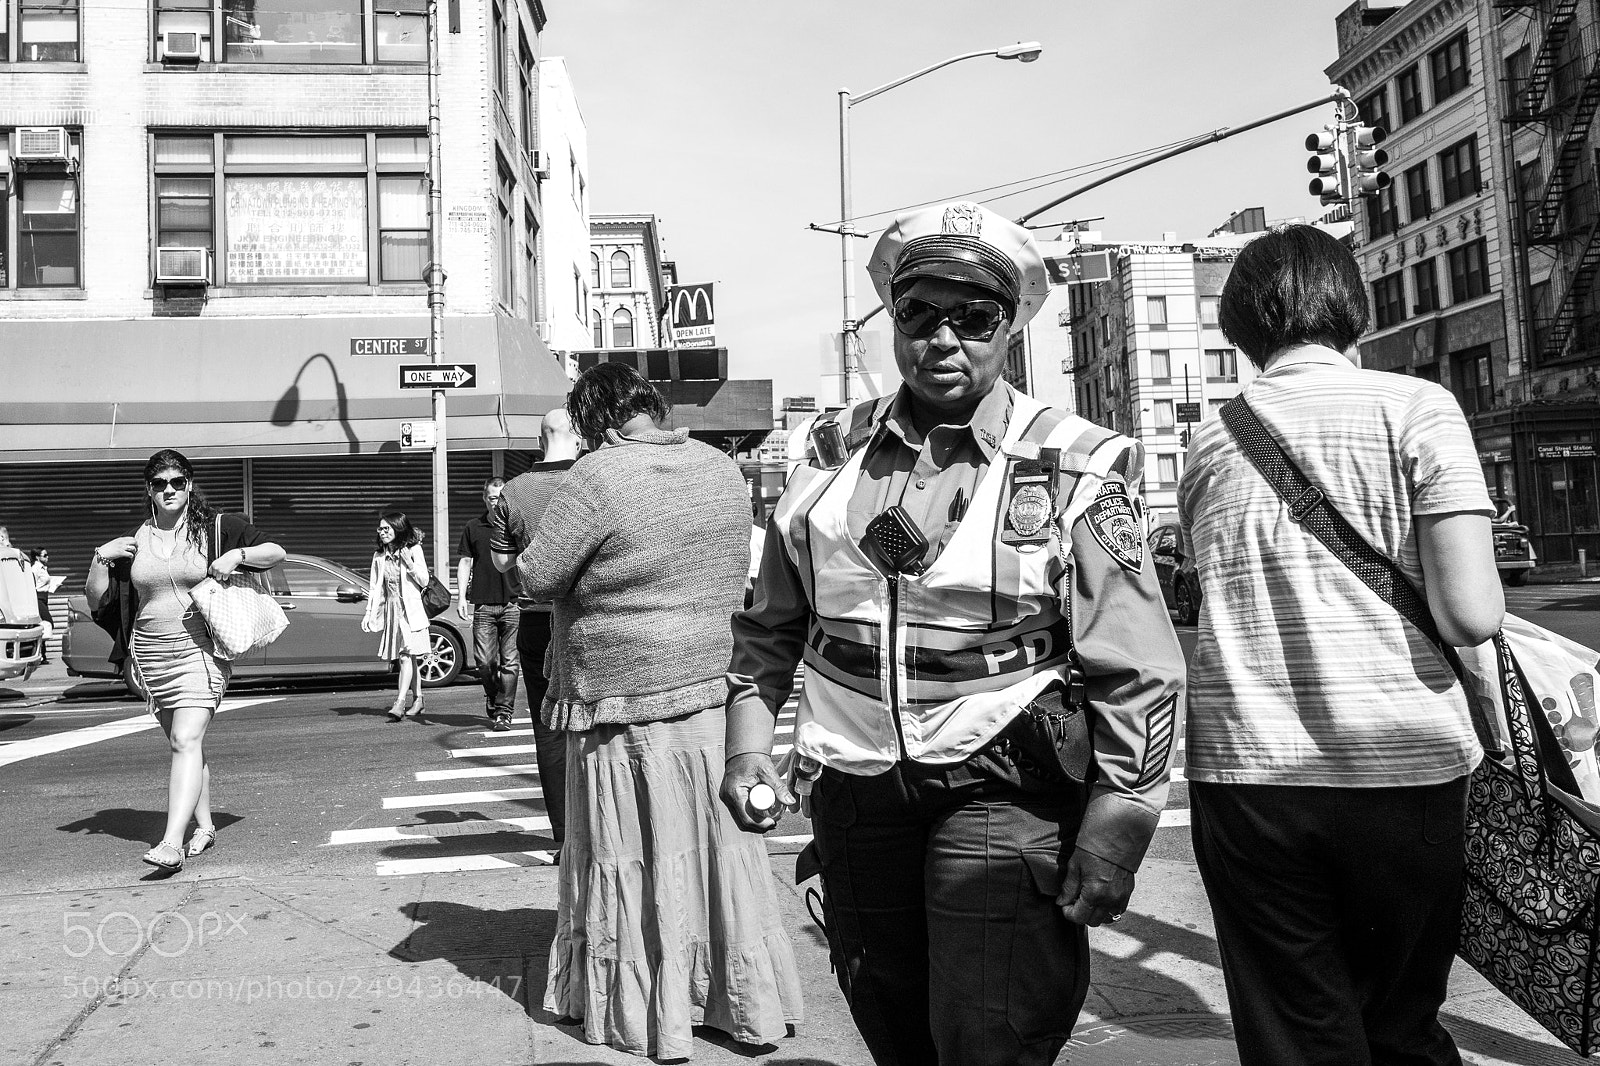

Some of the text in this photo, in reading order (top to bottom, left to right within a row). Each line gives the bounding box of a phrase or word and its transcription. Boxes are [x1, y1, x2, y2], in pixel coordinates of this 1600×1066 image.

[676, 326, 711, 338] OPEN LATE
[355, 339, 424, 354] CENTRE ST
[410, 371, 465, 382] ONE WAY
[1096, 484, 1122, 497] RAFFIC
[1100, 498, 1125, 511] POLICE
[1093, 506, 1133, 524] DEPARTMENT
[1101, 534, 1129, 561] CITY OF
[981, 630, 1053, 675] PD
